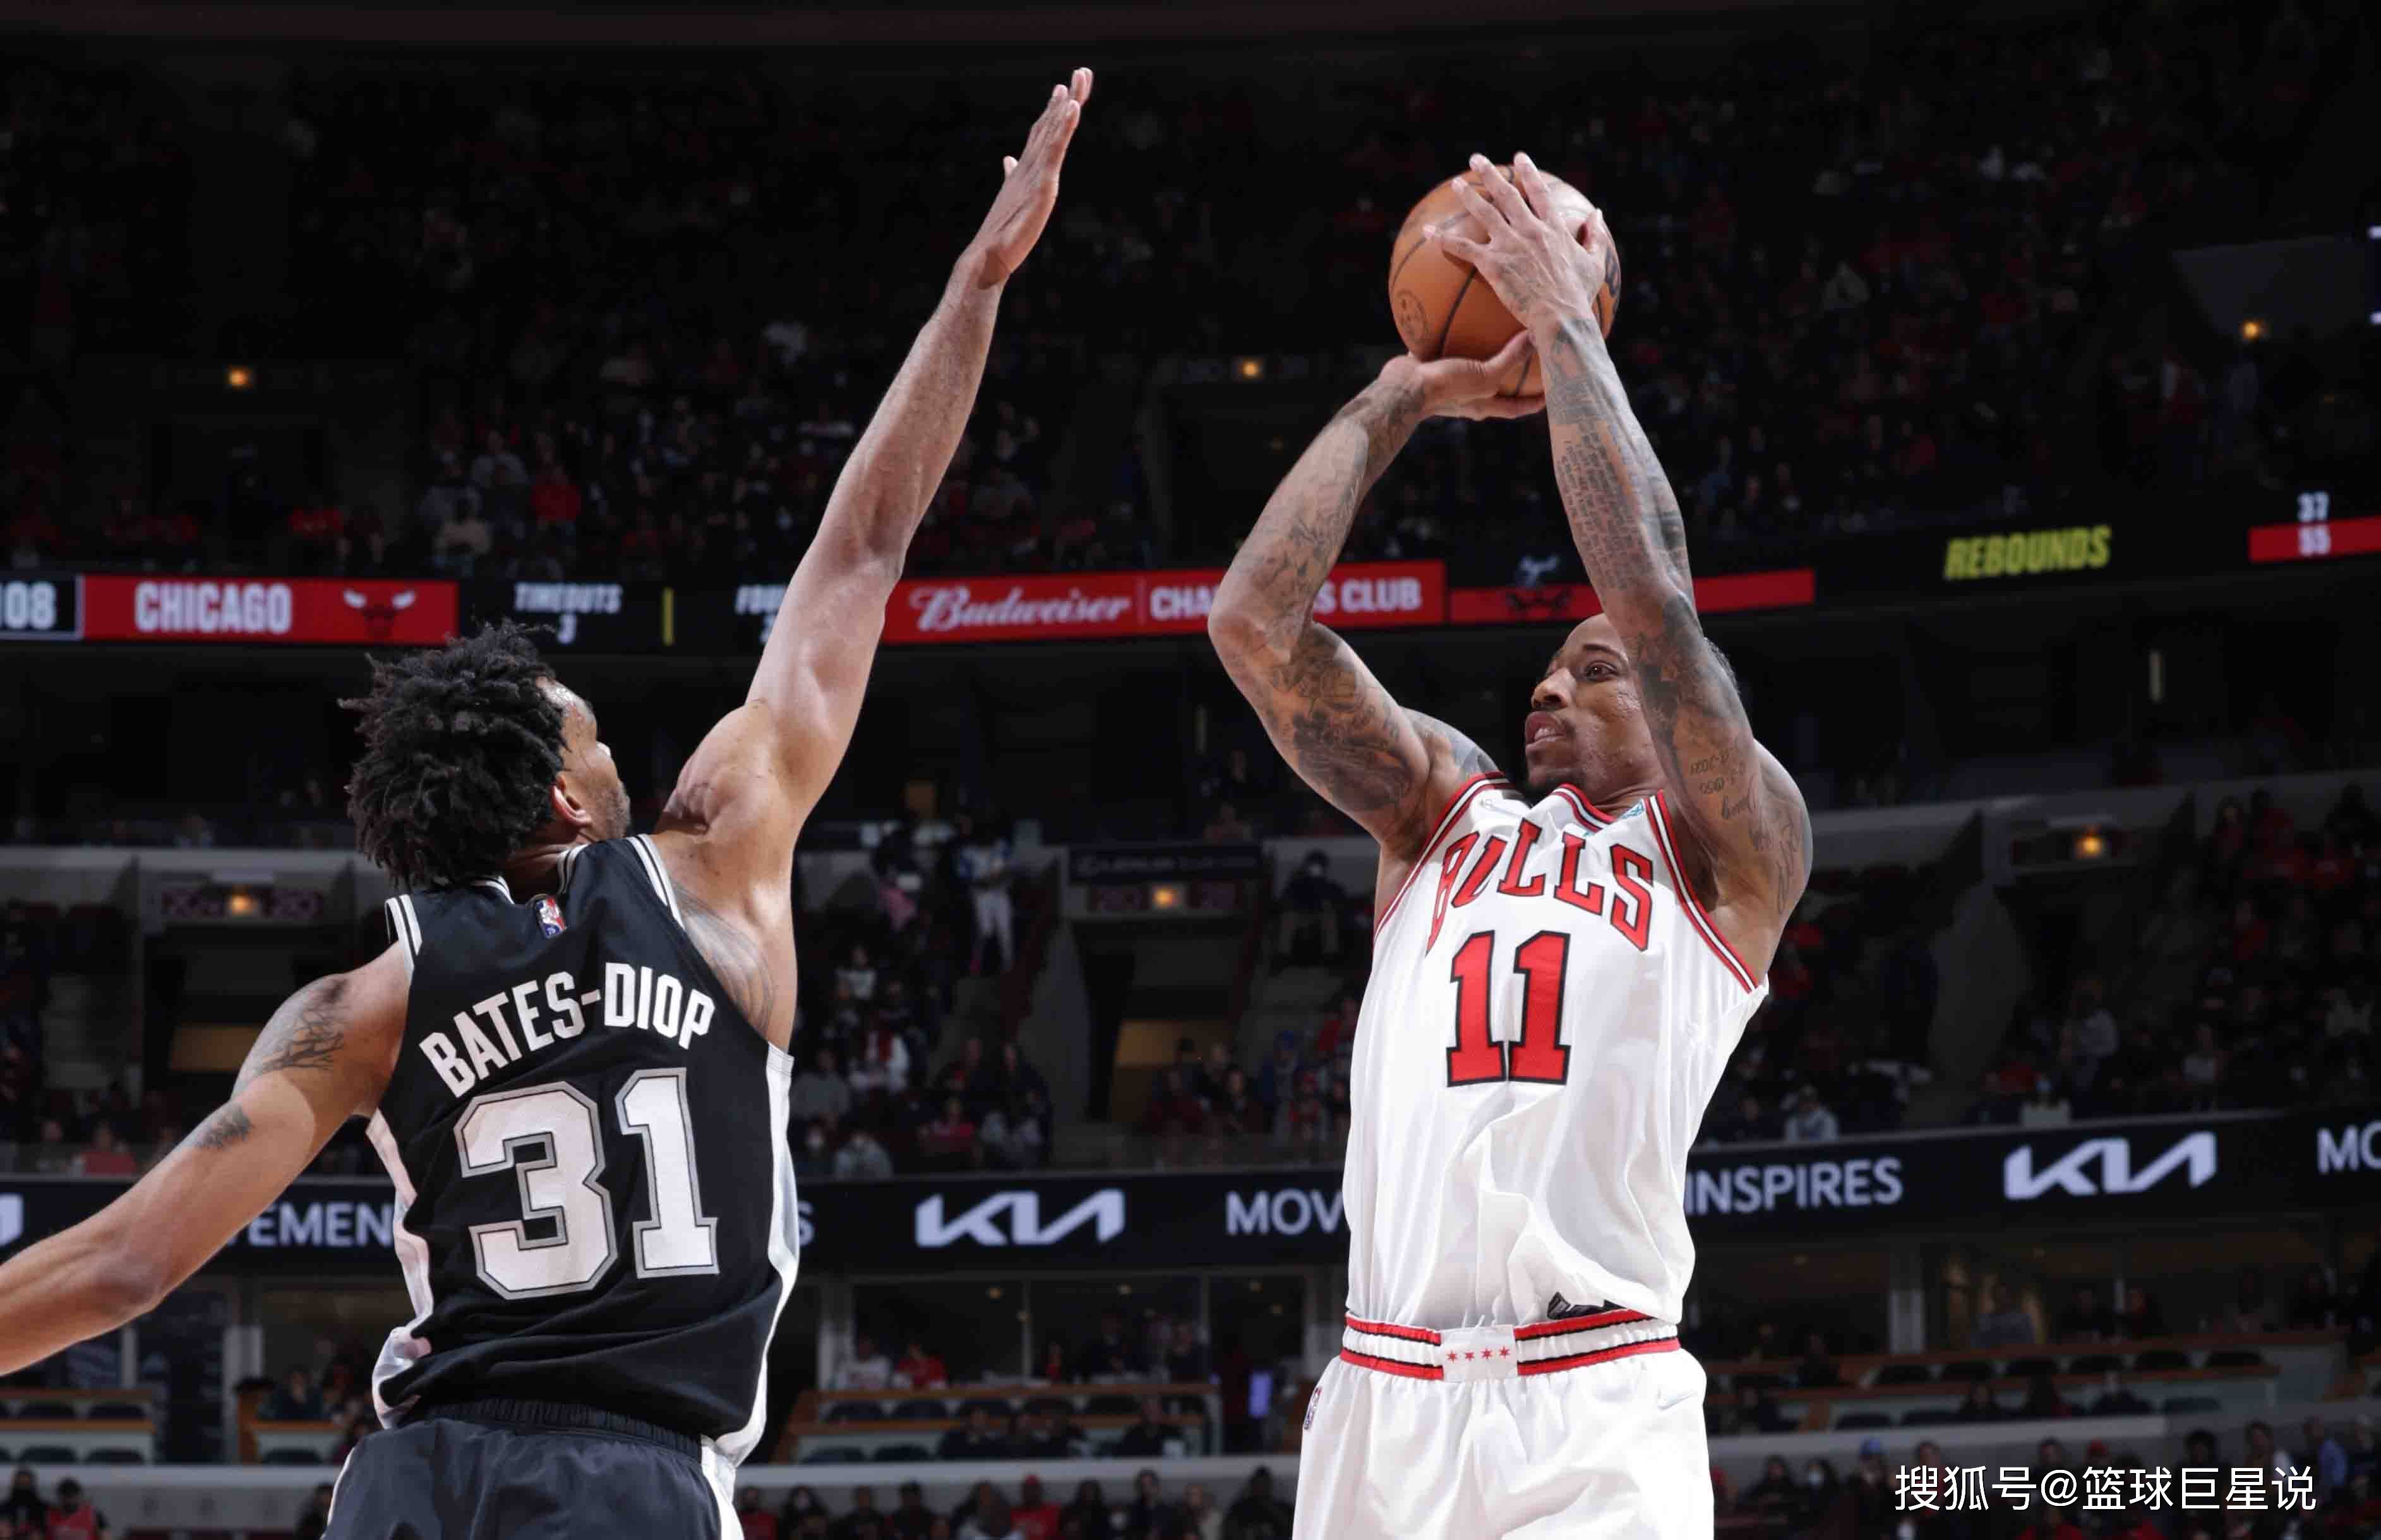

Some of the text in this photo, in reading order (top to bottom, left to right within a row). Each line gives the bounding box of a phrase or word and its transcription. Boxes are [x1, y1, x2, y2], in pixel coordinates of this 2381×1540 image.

[1943, 523, 2112, 580] REBOUNDS
[135, 582, 292, 634] CHICAGO
[909, 584, 1129, 631] Budweiser
[1340, 576, 1424, 614] CLUB
[1425, 818, 1654, 957] BULLS
[419, 962, 716, 1098] BATES-DIOP
[1446, 929, 1572, 1087] 11
[453, 1067, 721, 1301] 31
[1684, 1157, 1904, 1216] INSPIRES
